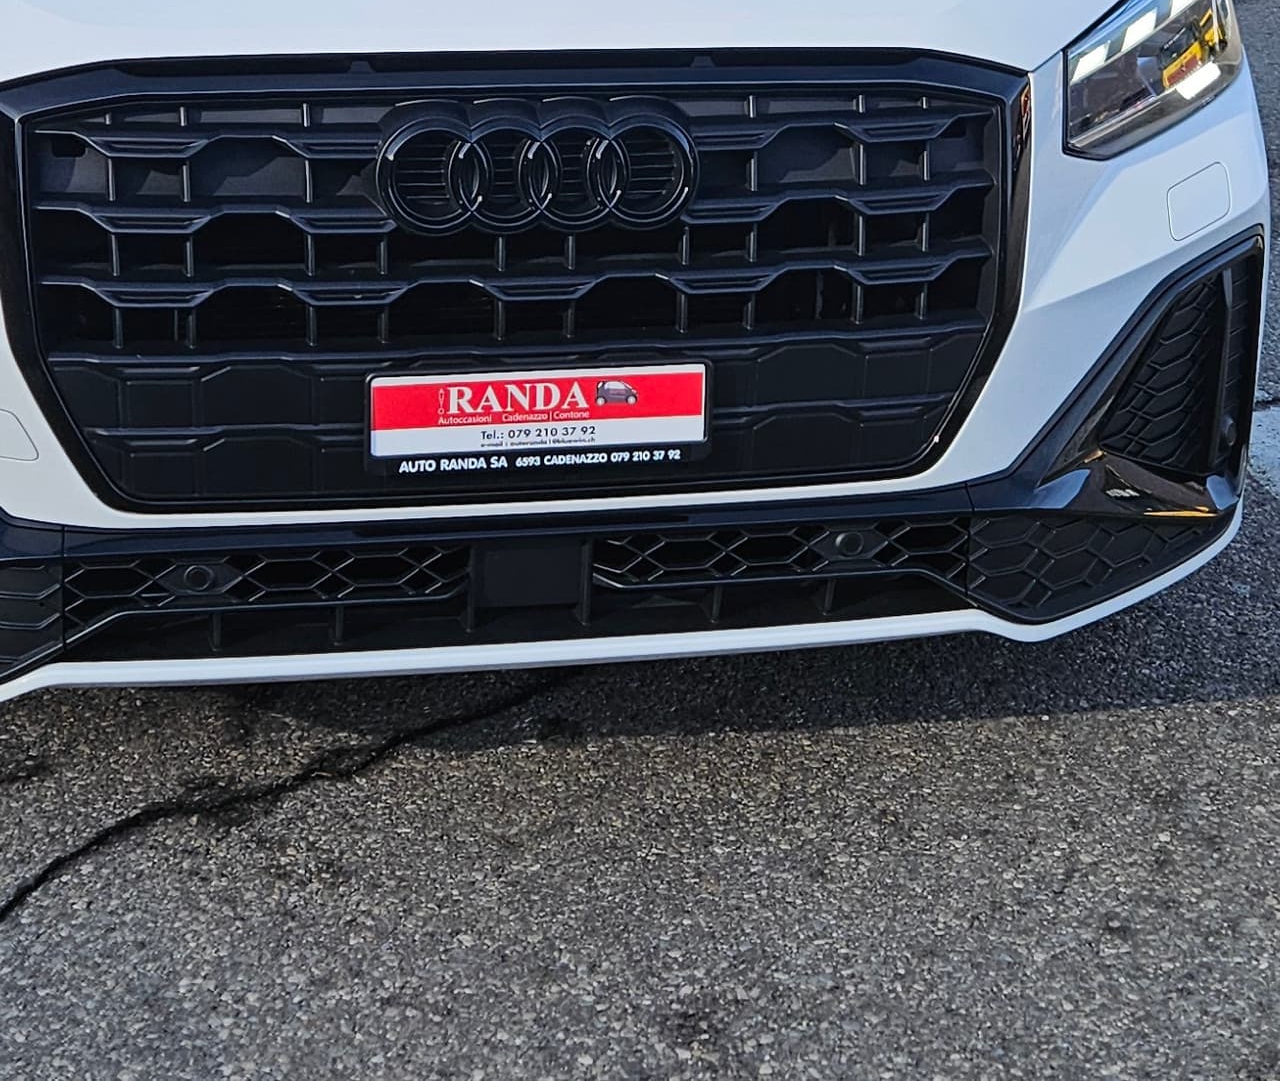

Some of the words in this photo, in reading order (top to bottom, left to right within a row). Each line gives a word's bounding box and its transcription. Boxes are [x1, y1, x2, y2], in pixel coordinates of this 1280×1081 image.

[447, 381, 590, 414] RANDA
[438, 415, 492, 425] Autoccasioni
[502, 412, 548, 422] Cadenazzo
[553, 410, 590, 419] Contone
[481, 430, 504, 439] Tel.:
[508, 429, 531, 439] 079
[535, 427, 558, 437] 210
[561, 426, 577, 436] 37
[580, 425, 596, 435] 92
[399, 460, 436, 473] AUTO
[440, 458, 487, 471] RANDA
[490, 456, 508, 468] SA
[515, 456, 540, 468] 6593
[544, 452, 607, 465] CADENAZZO
[610, 451, 630, 462] 079
[632, 450, 650, 462] 210
[652, 450, 665, 461] 37
[668, 449, 681, 459] 92
